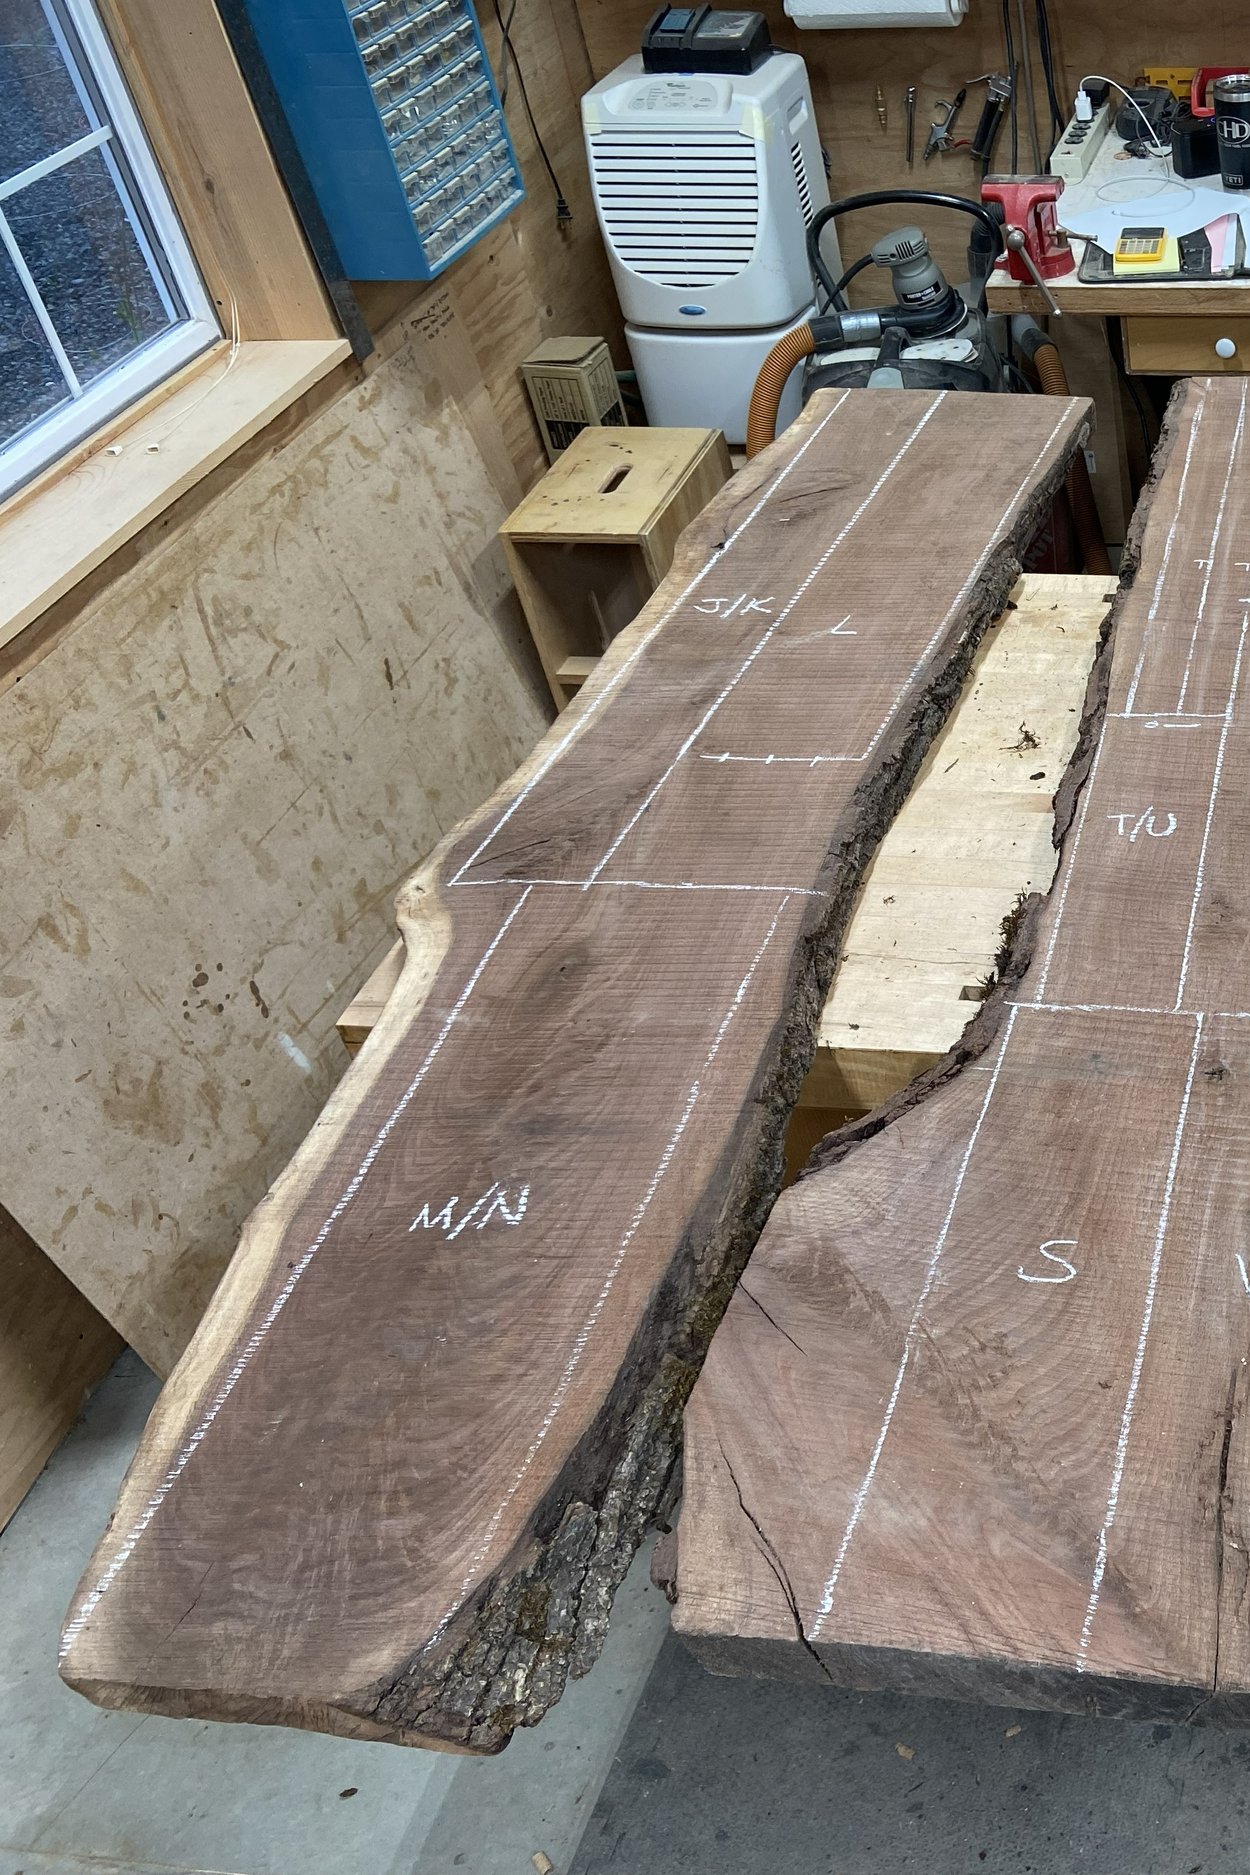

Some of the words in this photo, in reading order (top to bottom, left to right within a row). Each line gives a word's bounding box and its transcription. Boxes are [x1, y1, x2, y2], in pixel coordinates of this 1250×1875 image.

[1224, 174, 1242, 184] YETI
[692, 592, 777, 619] J/K
[1106, 805, 1179, 844] T/U
[408, 1181, 530, 1241] M/N
[1017, 1239, 1079, 1285] S
